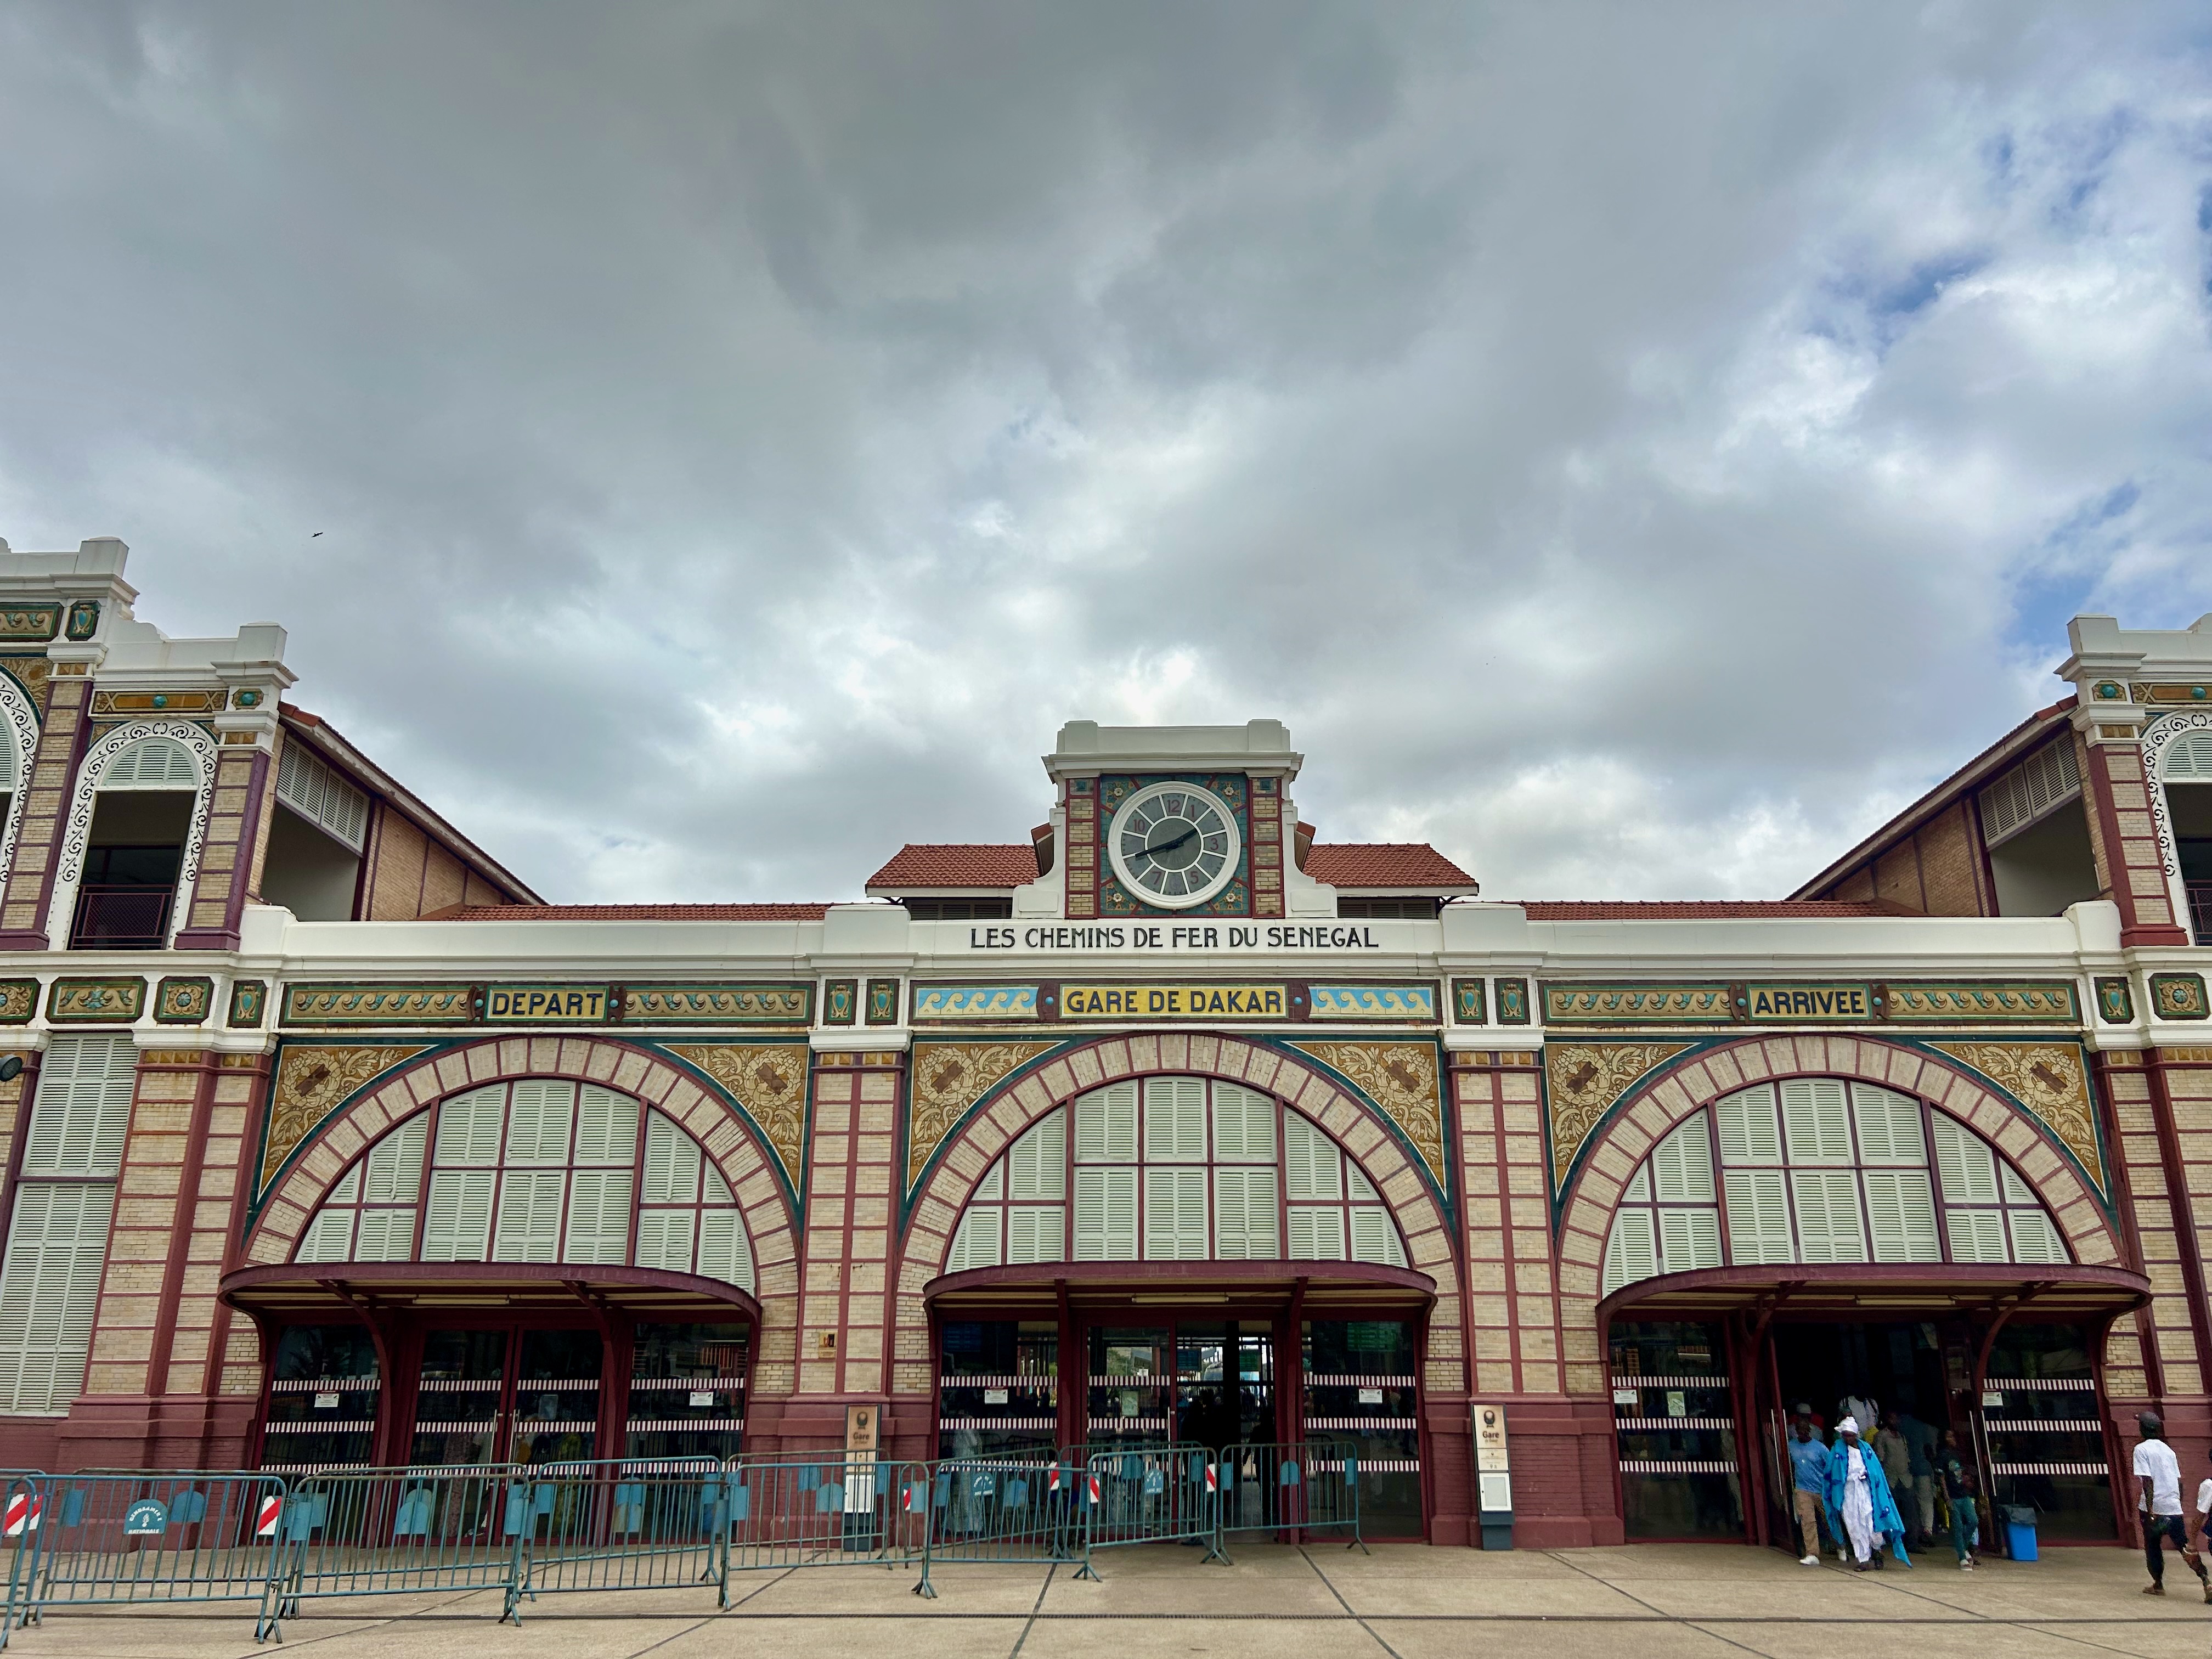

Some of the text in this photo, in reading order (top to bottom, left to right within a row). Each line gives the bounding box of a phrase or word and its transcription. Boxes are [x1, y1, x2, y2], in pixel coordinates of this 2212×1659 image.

[1167, 799, 1181, 813] 12
[1190, 804, 1195, 817] 1
[1133, 819, 1146, 832] 10
[1210, 838, 1219, 851] 3
[1152, 871, 1163, 885] 7
[1190, 871, 1199, 884] 5
[970, 927, 1379, 948] LES CHEMINS DE FER DU SENEGAL
[492, 992, 603, 1015] DEPART
[1066, 990, 1281, 1013] GARE DE DAKAR
[1754, 991, 1865, 1014] ARRIVEE
[853, 1432, 870, 1440] Gare
[1482, 1430, 1499, 1438] Gare
